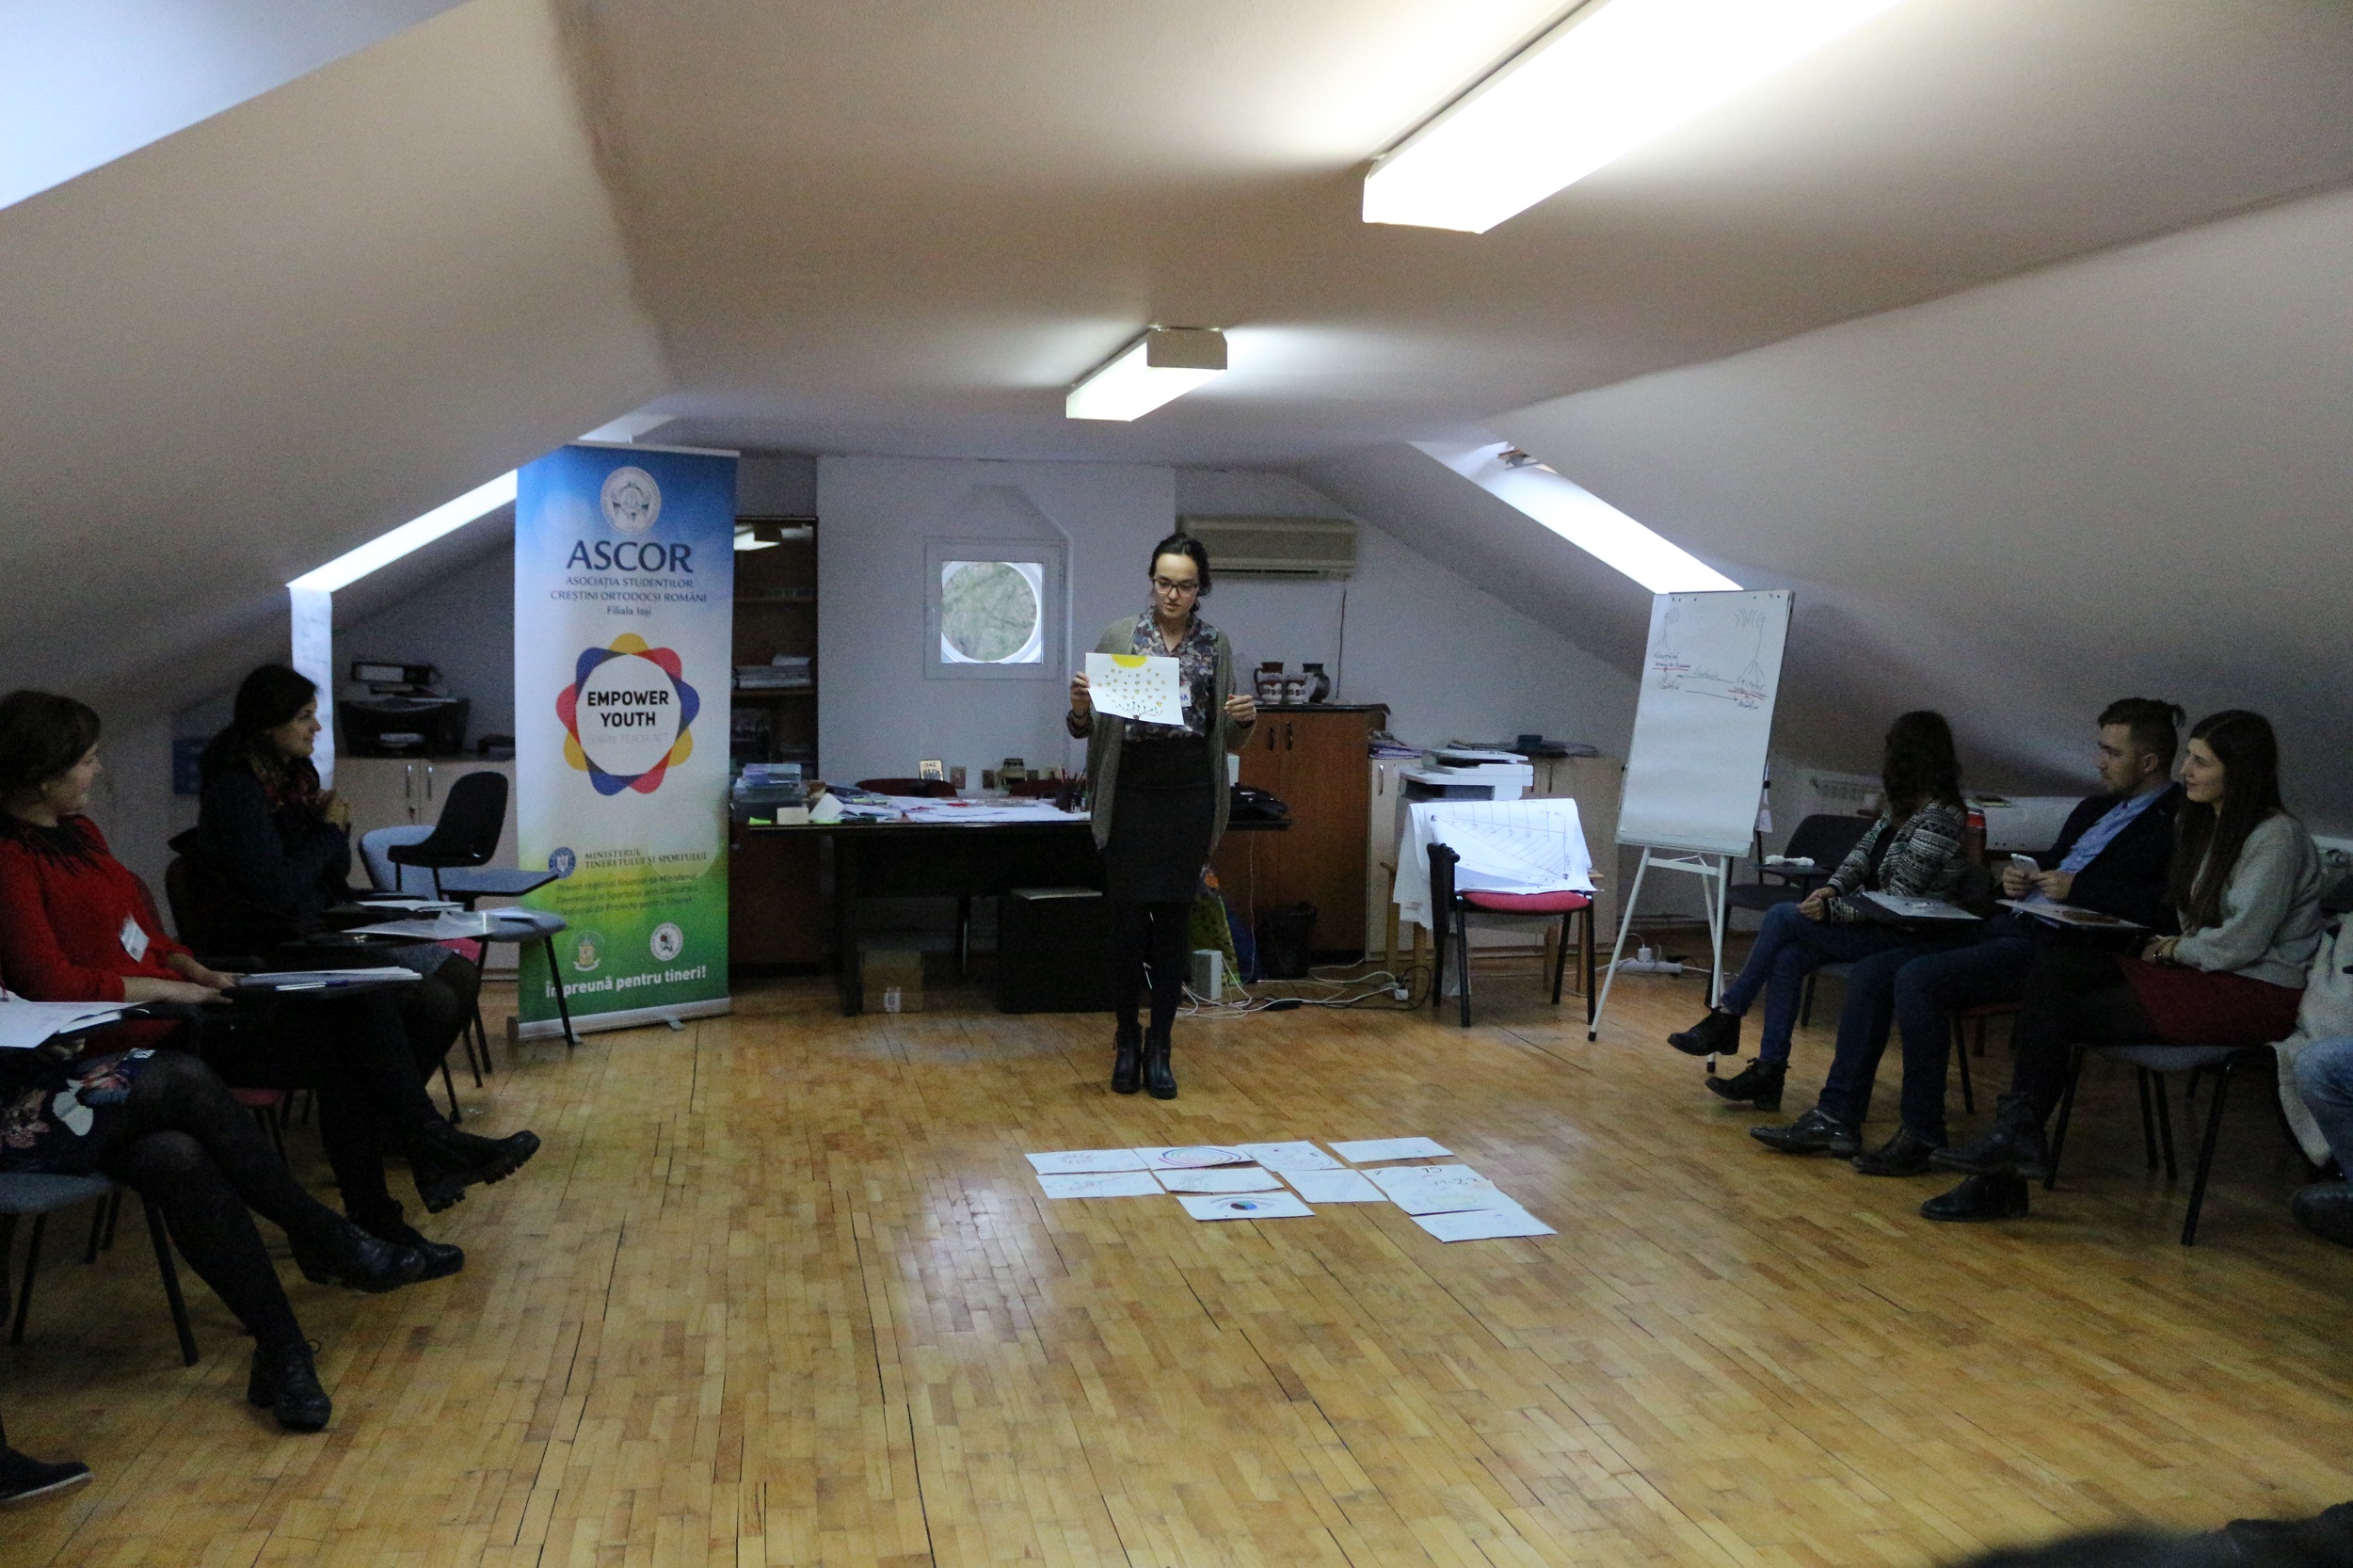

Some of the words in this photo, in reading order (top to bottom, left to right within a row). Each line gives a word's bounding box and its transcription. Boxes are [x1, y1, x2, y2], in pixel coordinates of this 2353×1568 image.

[566, 540, 694, 573] ASCOR
[607, 605, 633, 616] Filiala
[587, 690, 669, 707] EMPOWER
[600, 712, 656, 728] YOUTH
[585, 848, 641, 860] MINISTERUL
[585, 856, 645, 869] TINERETULUI
[658, 852, 707, 863] SPORTULUI
[616, 971, 662, 991] pentru
[664, 965, 707, 983] tineri!
